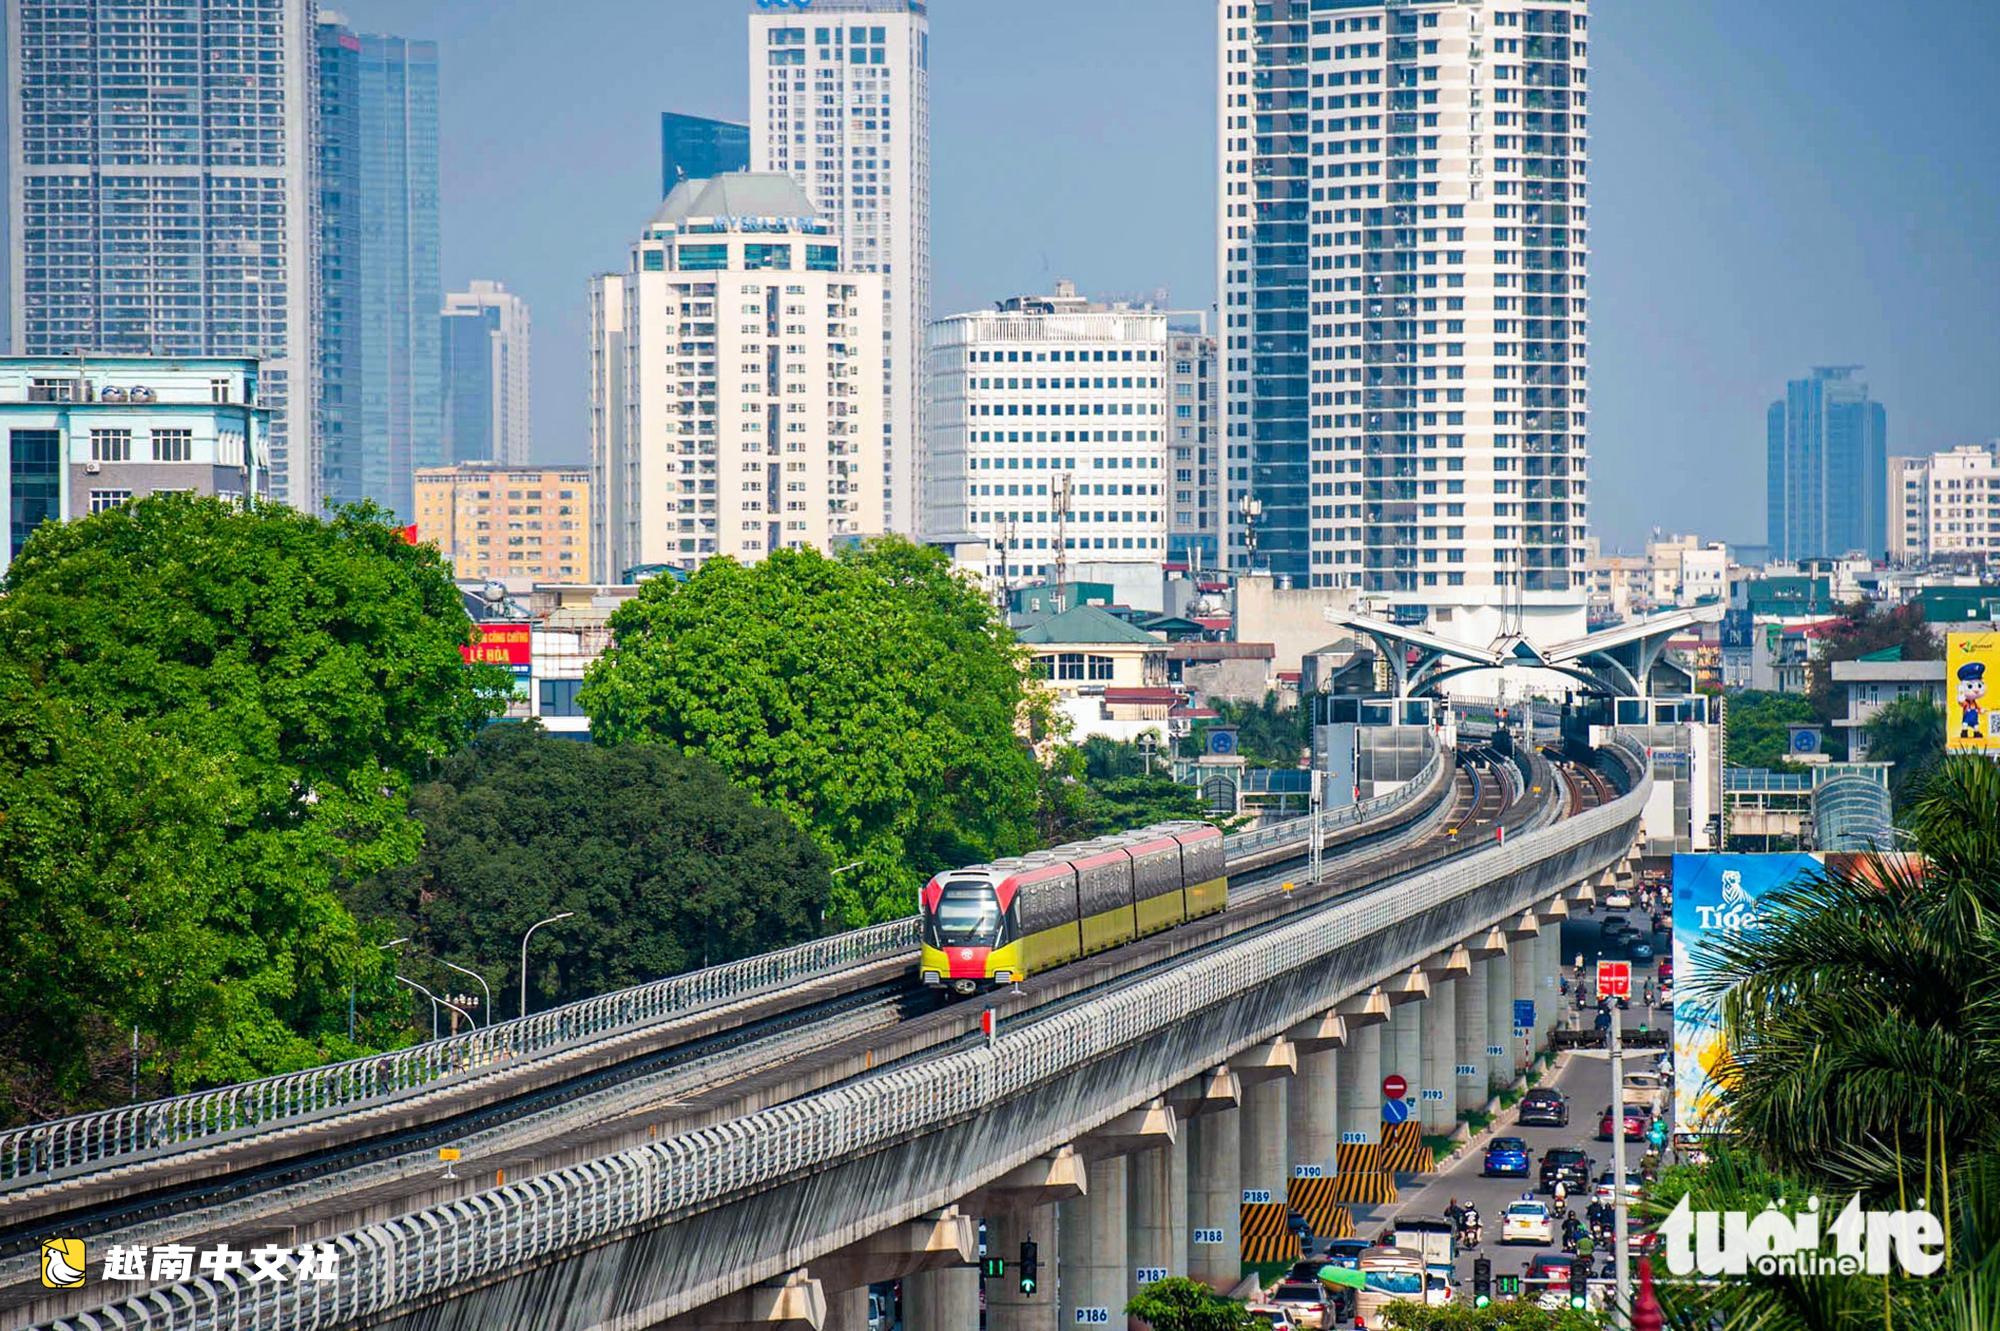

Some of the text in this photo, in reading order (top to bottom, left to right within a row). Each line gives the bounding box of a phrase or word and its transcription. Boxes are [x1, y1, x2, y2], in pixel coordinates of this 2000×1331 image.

[1423, 1091, 1443, 1099] P193
[1344, 1133, 1367, 1143] P191
[1296, 1167, 1321, 1176] P190
[1243, 1191, 1270, 1202] P189
[1194, 1230, 1223, 1242] P188
[1137, 1269, 1167, 1281] P187
[1076, 1309, 1108, 1322] P186
